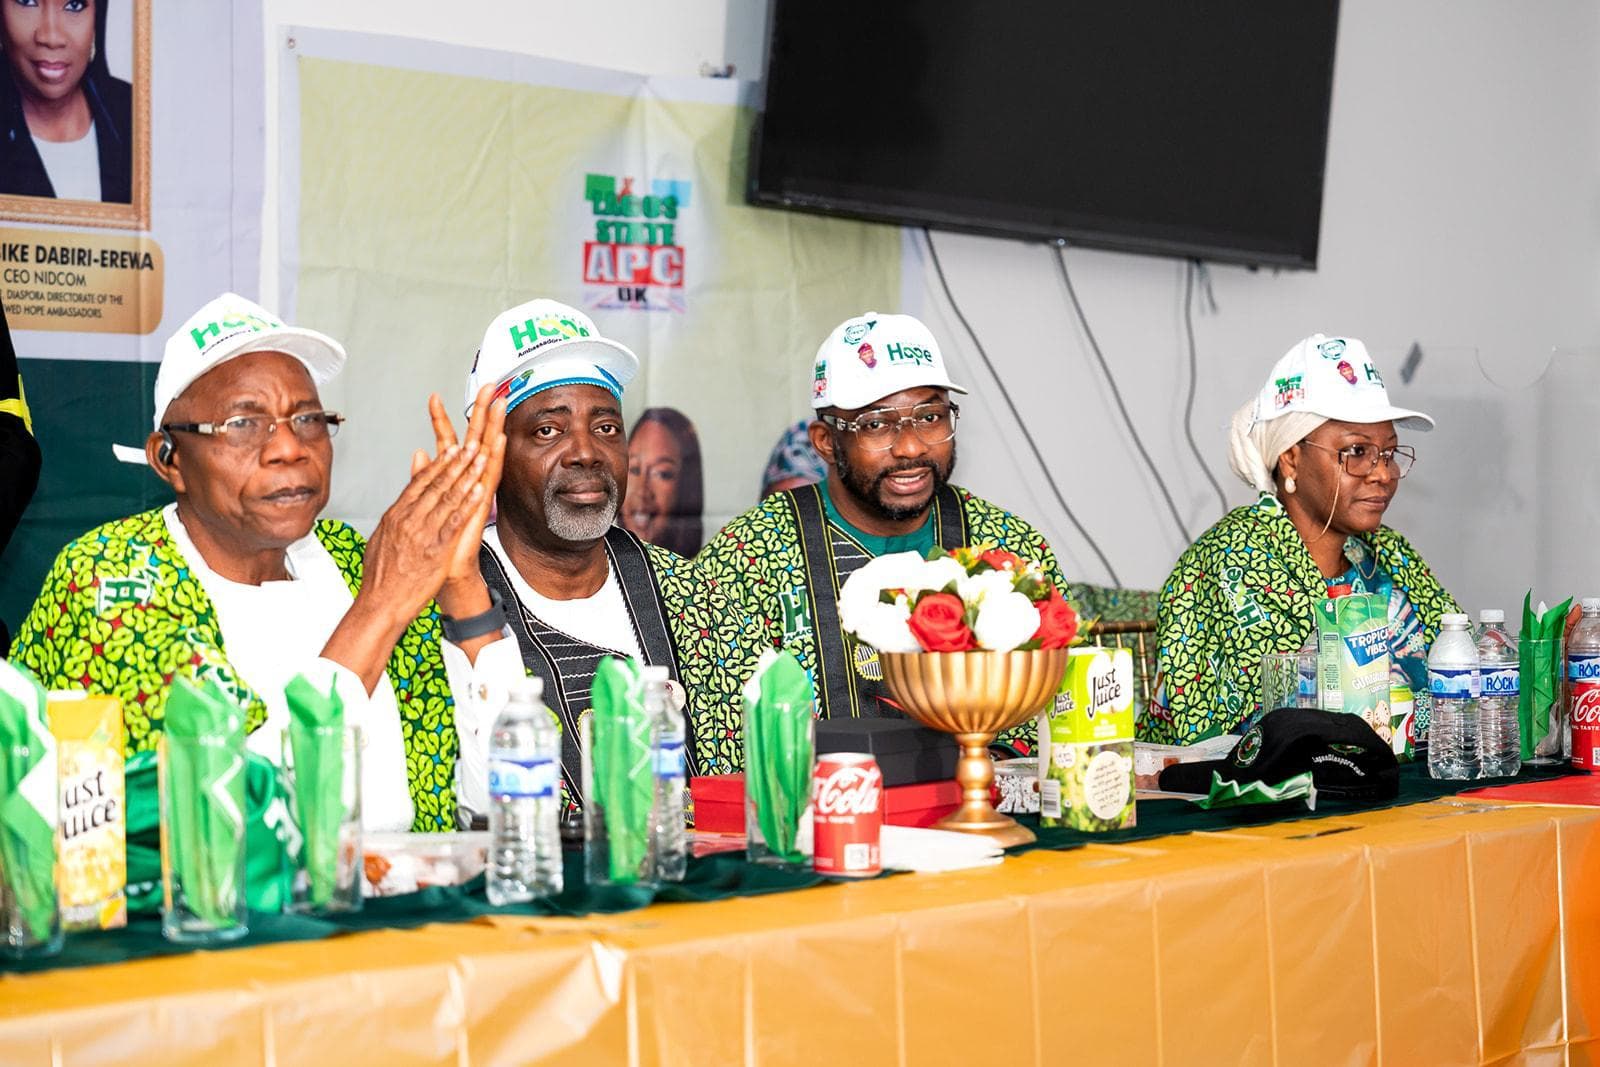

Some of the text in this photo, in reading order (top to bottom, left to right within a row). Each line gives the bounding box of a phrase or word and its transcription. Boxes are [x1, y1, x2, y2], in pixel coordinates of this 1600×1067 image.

[596, 219, 675, 246] STATE
[0, 243, 154, 271] IKE DABIRI-EREWA
[585, 243, 683, 285] APC
[4, 268, 87, 286] CEO NIDCOM
[7, 290, 124, 305] DIASPORA DIRECTORATE OF THE
[618, 287, 646, 303] UK
[4, 304, 103, 319] WED HOPE AMBASSADORS
[886, 342, 933, 366] Hope
[1365, 640, 1388, 657] VIBES
[1578, 662, 1600, 678] ROC
[64, 770, 103, 809] ust
[63, 799, 116, 840] uice
